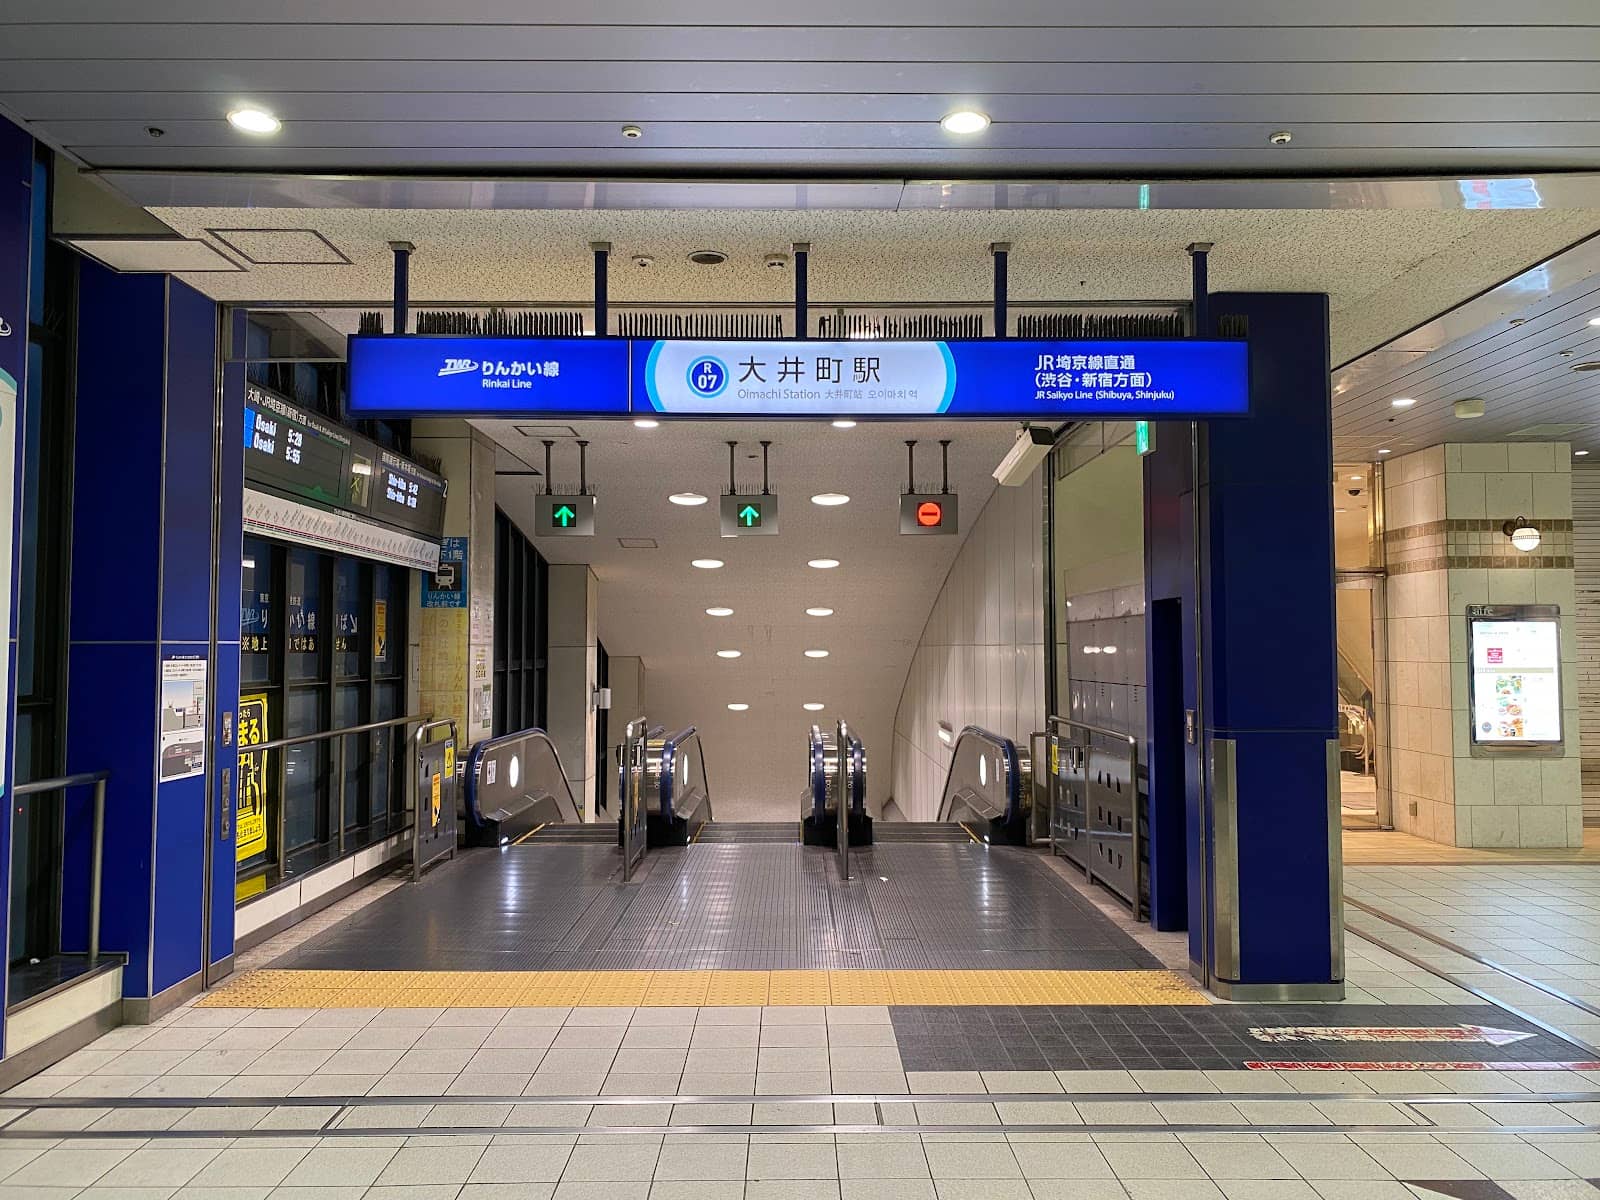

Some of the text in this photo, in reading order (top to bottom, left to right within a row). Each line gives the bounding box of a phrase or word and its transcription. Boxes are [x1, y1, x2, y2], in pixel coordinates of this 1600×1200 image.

[482, 360, 559, 377] りんかい線
[703, 362, 712, 373] R
[1034, 354, 1135, 371] JR埼京線直通
[738, 355, 881, 384] 大井町駅
[482, 379, 532, 389] Rinkai Line
[697, 375, 717, 389] 07
[737, 388, 821, 400] Oimachi Station
[1034, 391, 1174, 401] JR Saikyo Line (Shibuya, Shinjuku)
